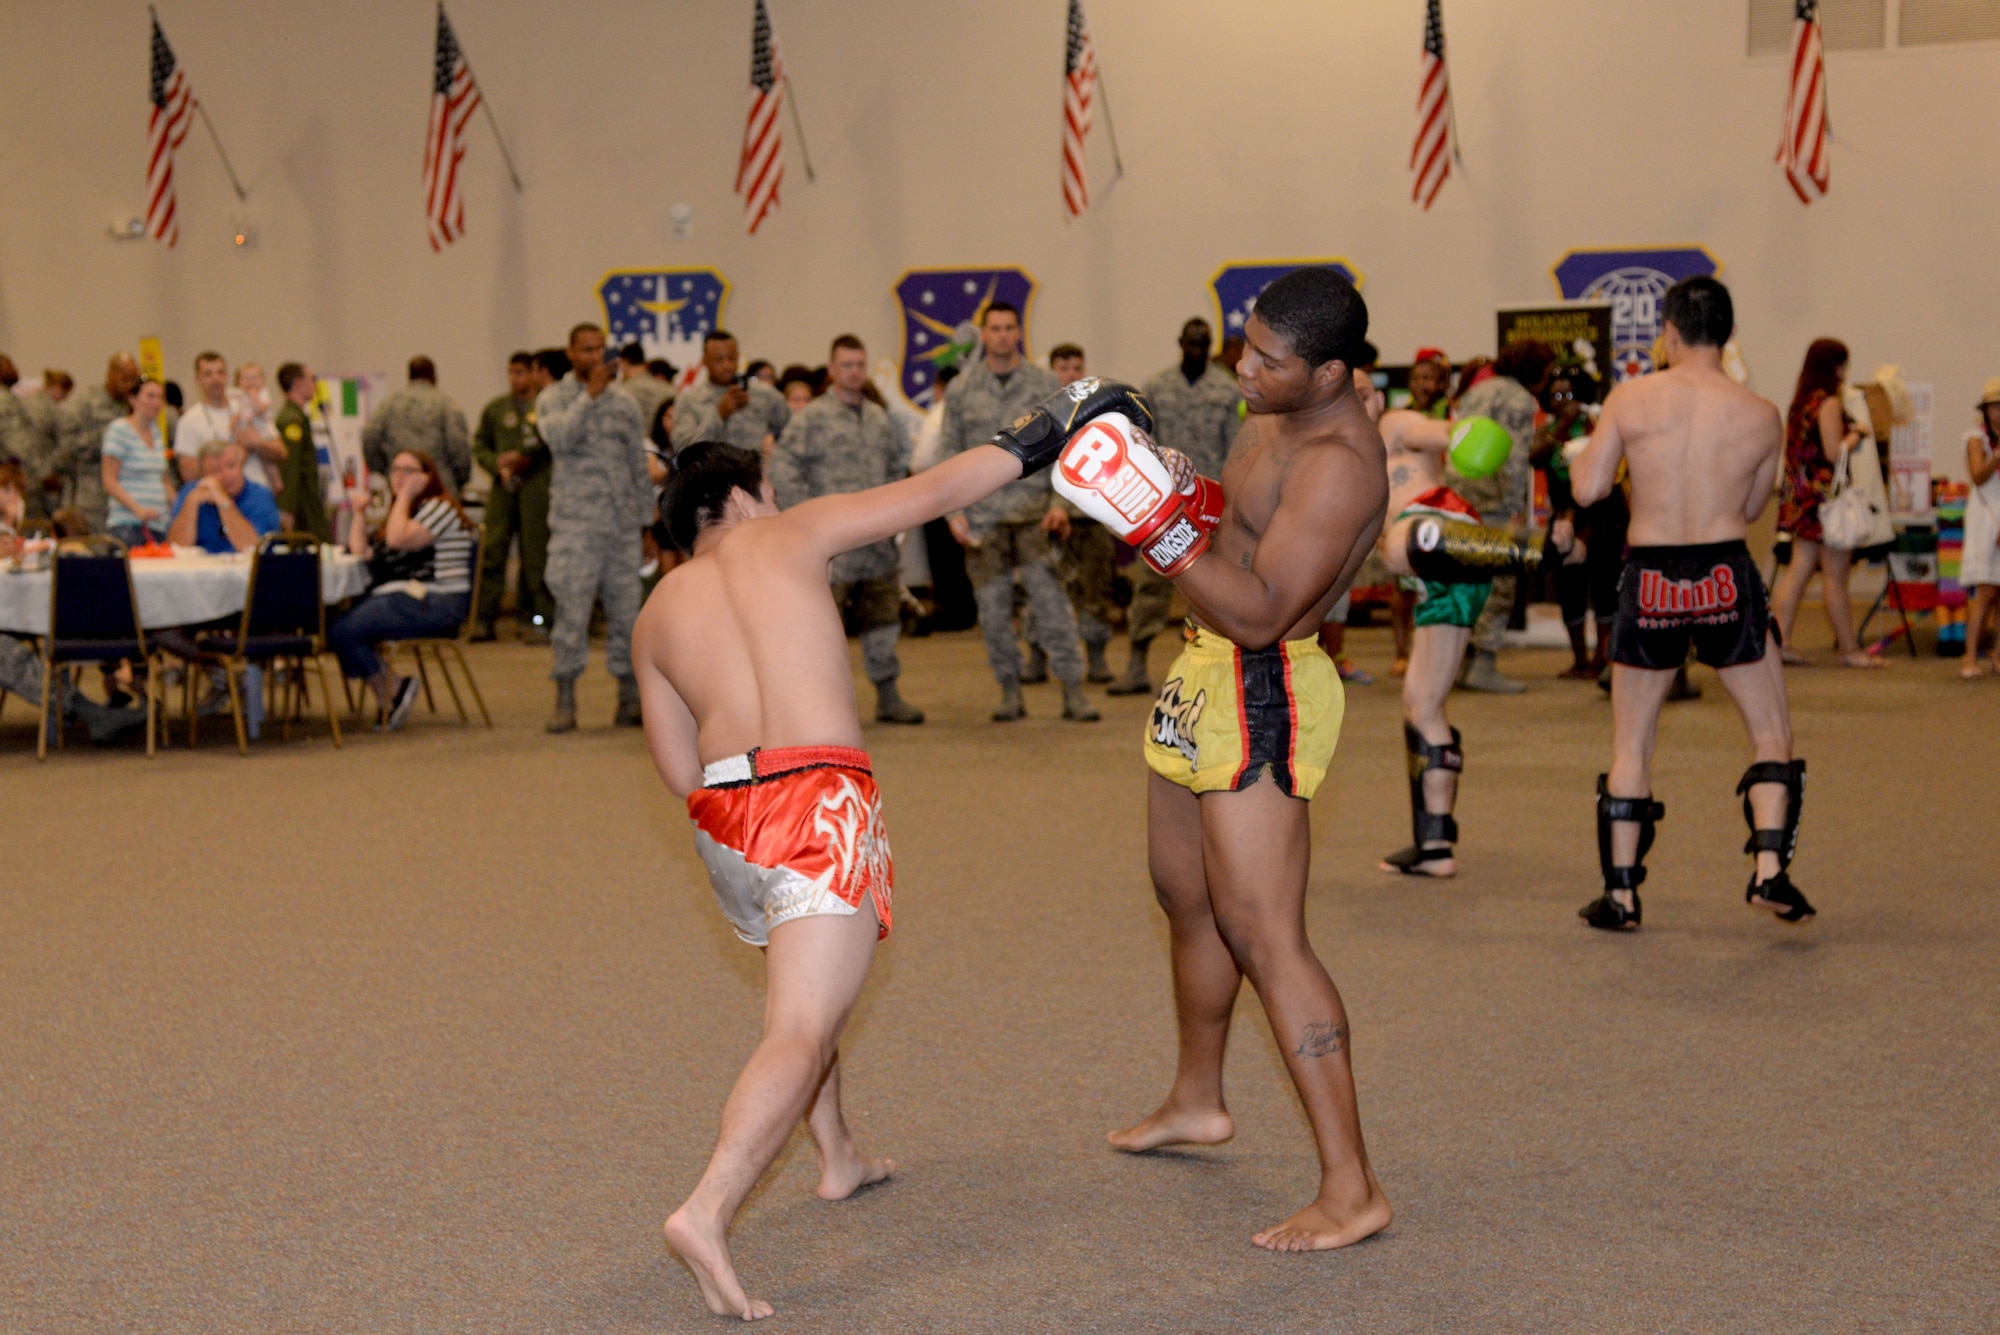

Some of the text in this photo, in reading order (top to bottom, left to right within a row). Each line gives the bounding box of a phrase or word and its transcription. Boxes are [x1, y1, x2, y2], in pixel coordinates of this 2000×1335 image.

[1615, 294, 1656, 325] 20
[1063, 425, 1119, 483] R
[1103, 463, 1161, 522] SIDE
[1149, 517, 1200, 569] RINGSIDE
